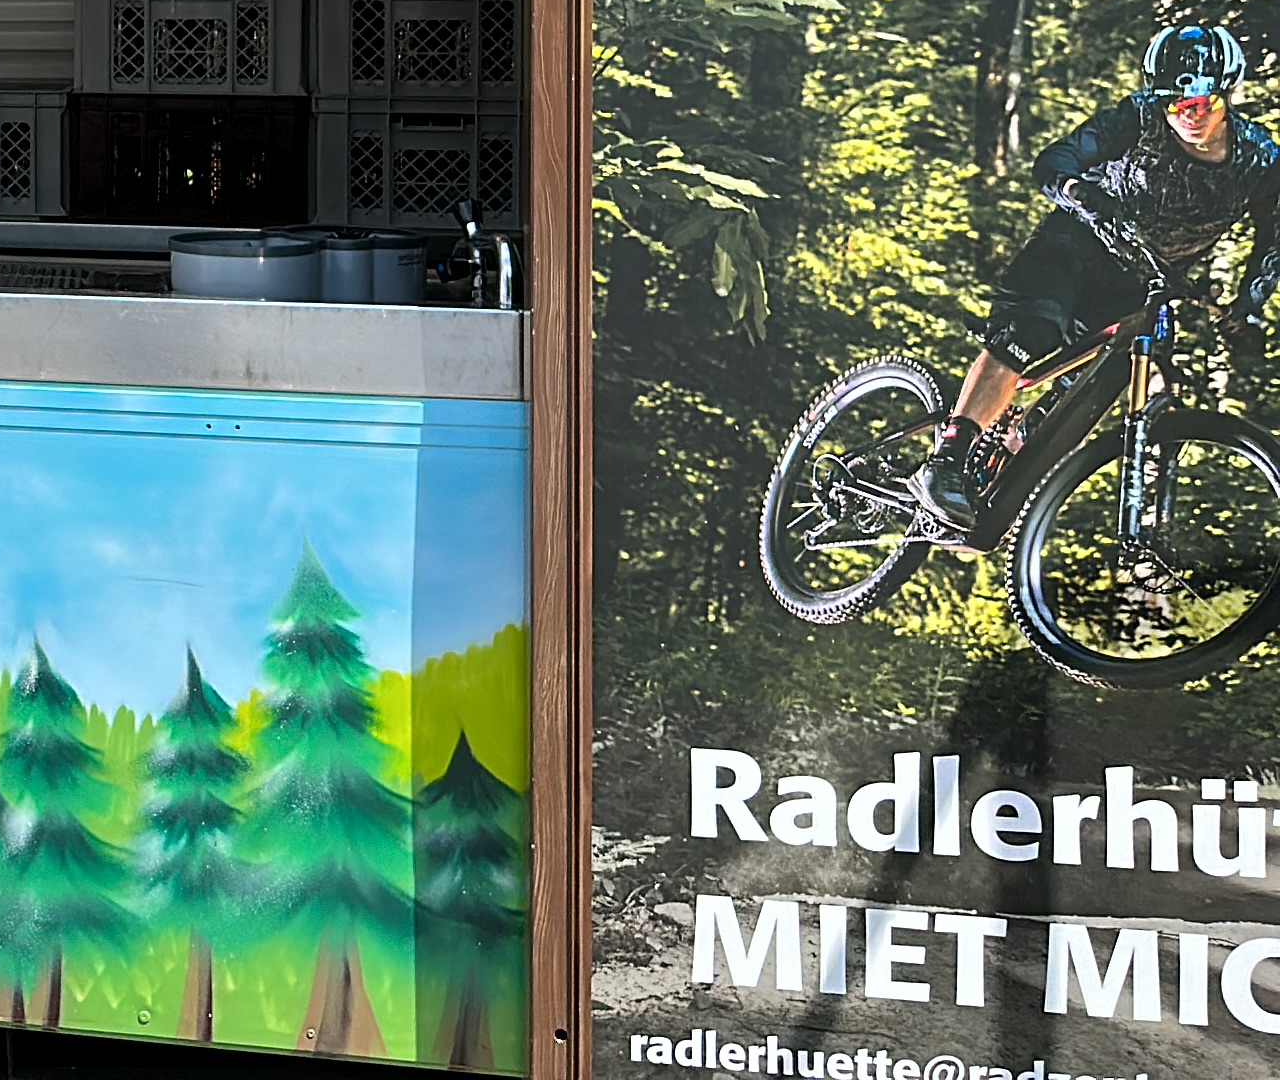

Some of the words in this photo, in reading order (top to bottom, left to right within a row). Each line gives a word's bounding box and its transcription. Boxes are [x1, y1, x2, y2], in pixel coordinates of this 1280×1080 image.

[690, 747, 1280, 879] Radlerhü
[691, 894, 1008, 1007] MIET
[1044, 923, 1280, 1035] MIC
